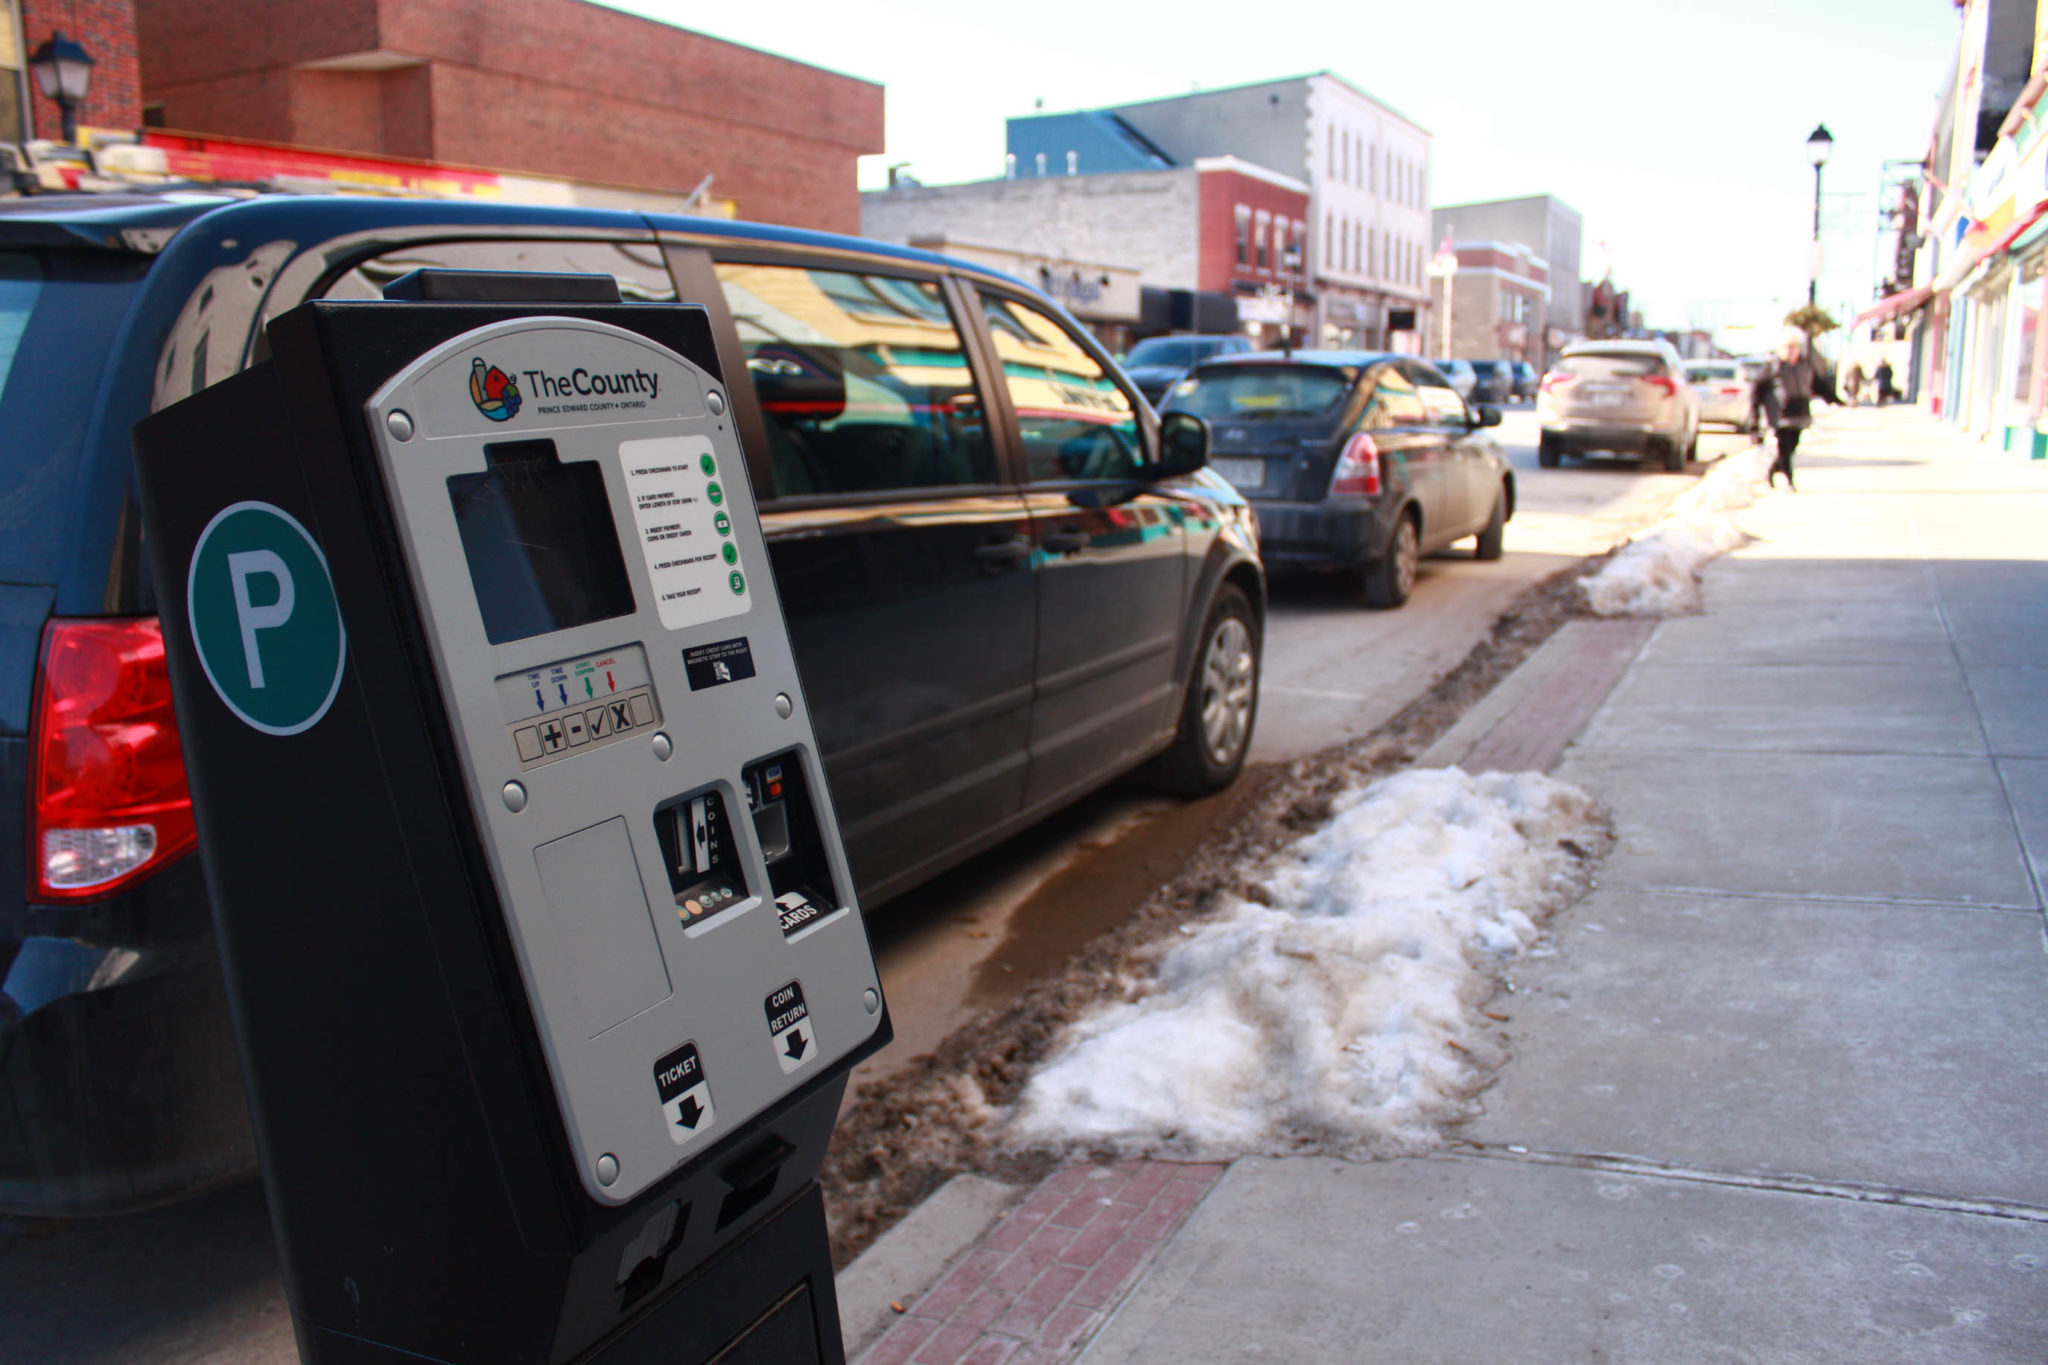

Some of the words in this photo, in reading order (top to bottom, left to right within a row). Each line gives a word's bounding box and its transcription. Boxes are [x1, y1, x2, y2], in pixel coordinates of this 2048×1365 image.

[523, 368, 658, 399] TheCounty
[537, 405, 560, 414] PRINCE
[562, 404, 588, 413] EDWARD
[589, 403, 614, 412] COUNTY
[620, 400, 646, 409] ONTARIO
[227, 549, 296, 689] P
[690, 649, 705, 657] INSERT
[706, 646, 720, 654] CREDIT
[595, 658, 616, 668] CANCEL
[527, 672, 541, 681] TIME
[551, 667, 564, 675] TIME
[574, 667, 595, 676] CONFIRM
[531, 681, 540, 689] UP
[551, 674, 568, 684] DOWN
[706, 797, 719, 864] COINS
[772, 986, 795, 1008] COIN
[770, 1002, 806, 1033] RETURN
[658, 1056, 697, 1088] TICKET
